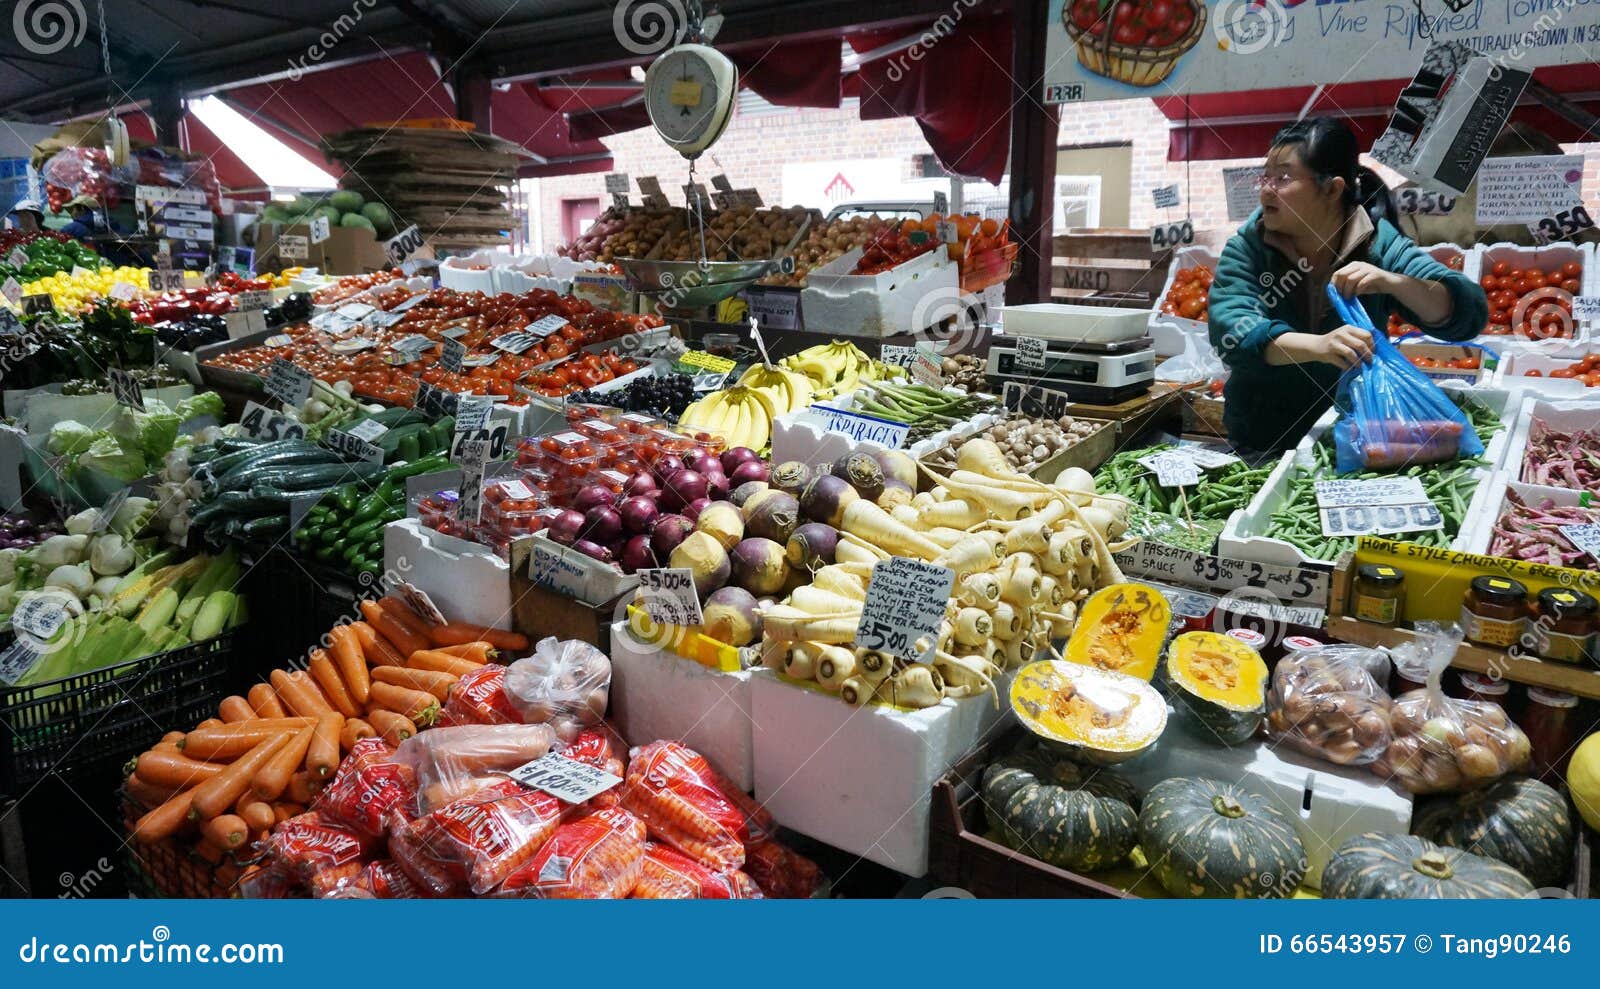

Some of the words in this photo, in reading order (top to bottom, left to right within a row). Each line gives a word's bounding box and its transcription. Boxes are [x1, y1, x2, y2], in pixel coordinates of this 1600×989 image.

[1317, 6, 1368, 38] Vine
[1525, 28, 1567, 48] GROWN
[1573, 25, 1586, 43] IN
[1455, 86, 1512, 173] Asparagus
[1514, 161, 1540, 169] Bridge
[1401, 189, 1456, 214] 350
[1538, 205, 1595, 240] 350
[1152, 223, 1195, 248] 400
[1063, 268, 1110, 291] M&D
[883, 346, 904, 354] SWISS
[1019, 337, 1041, 347] SWISS
[824, 416, 901, 450] ASPARAGUS
[1317, 484, 1402, 493] HARVESTED
[1326, 504, 1442, 533] 1000
[1143, 542, 1193, 562] PASSATA
[1361, 539, 1399, 554] HOME
[1407, 545, 1449, 560] STYLE
[876, 564, 911, 580] SWEDE
[890, 558, 947, 576] TASMANIAN
[1142, 559, 1176, 575] SAUCE
[872, 582, 917, 600] STRONGER
[876, 575, 908, 588] YELLOW
[909, 581, 935, 595] FLESH
[863, 608, 907, 627] SWEETER
